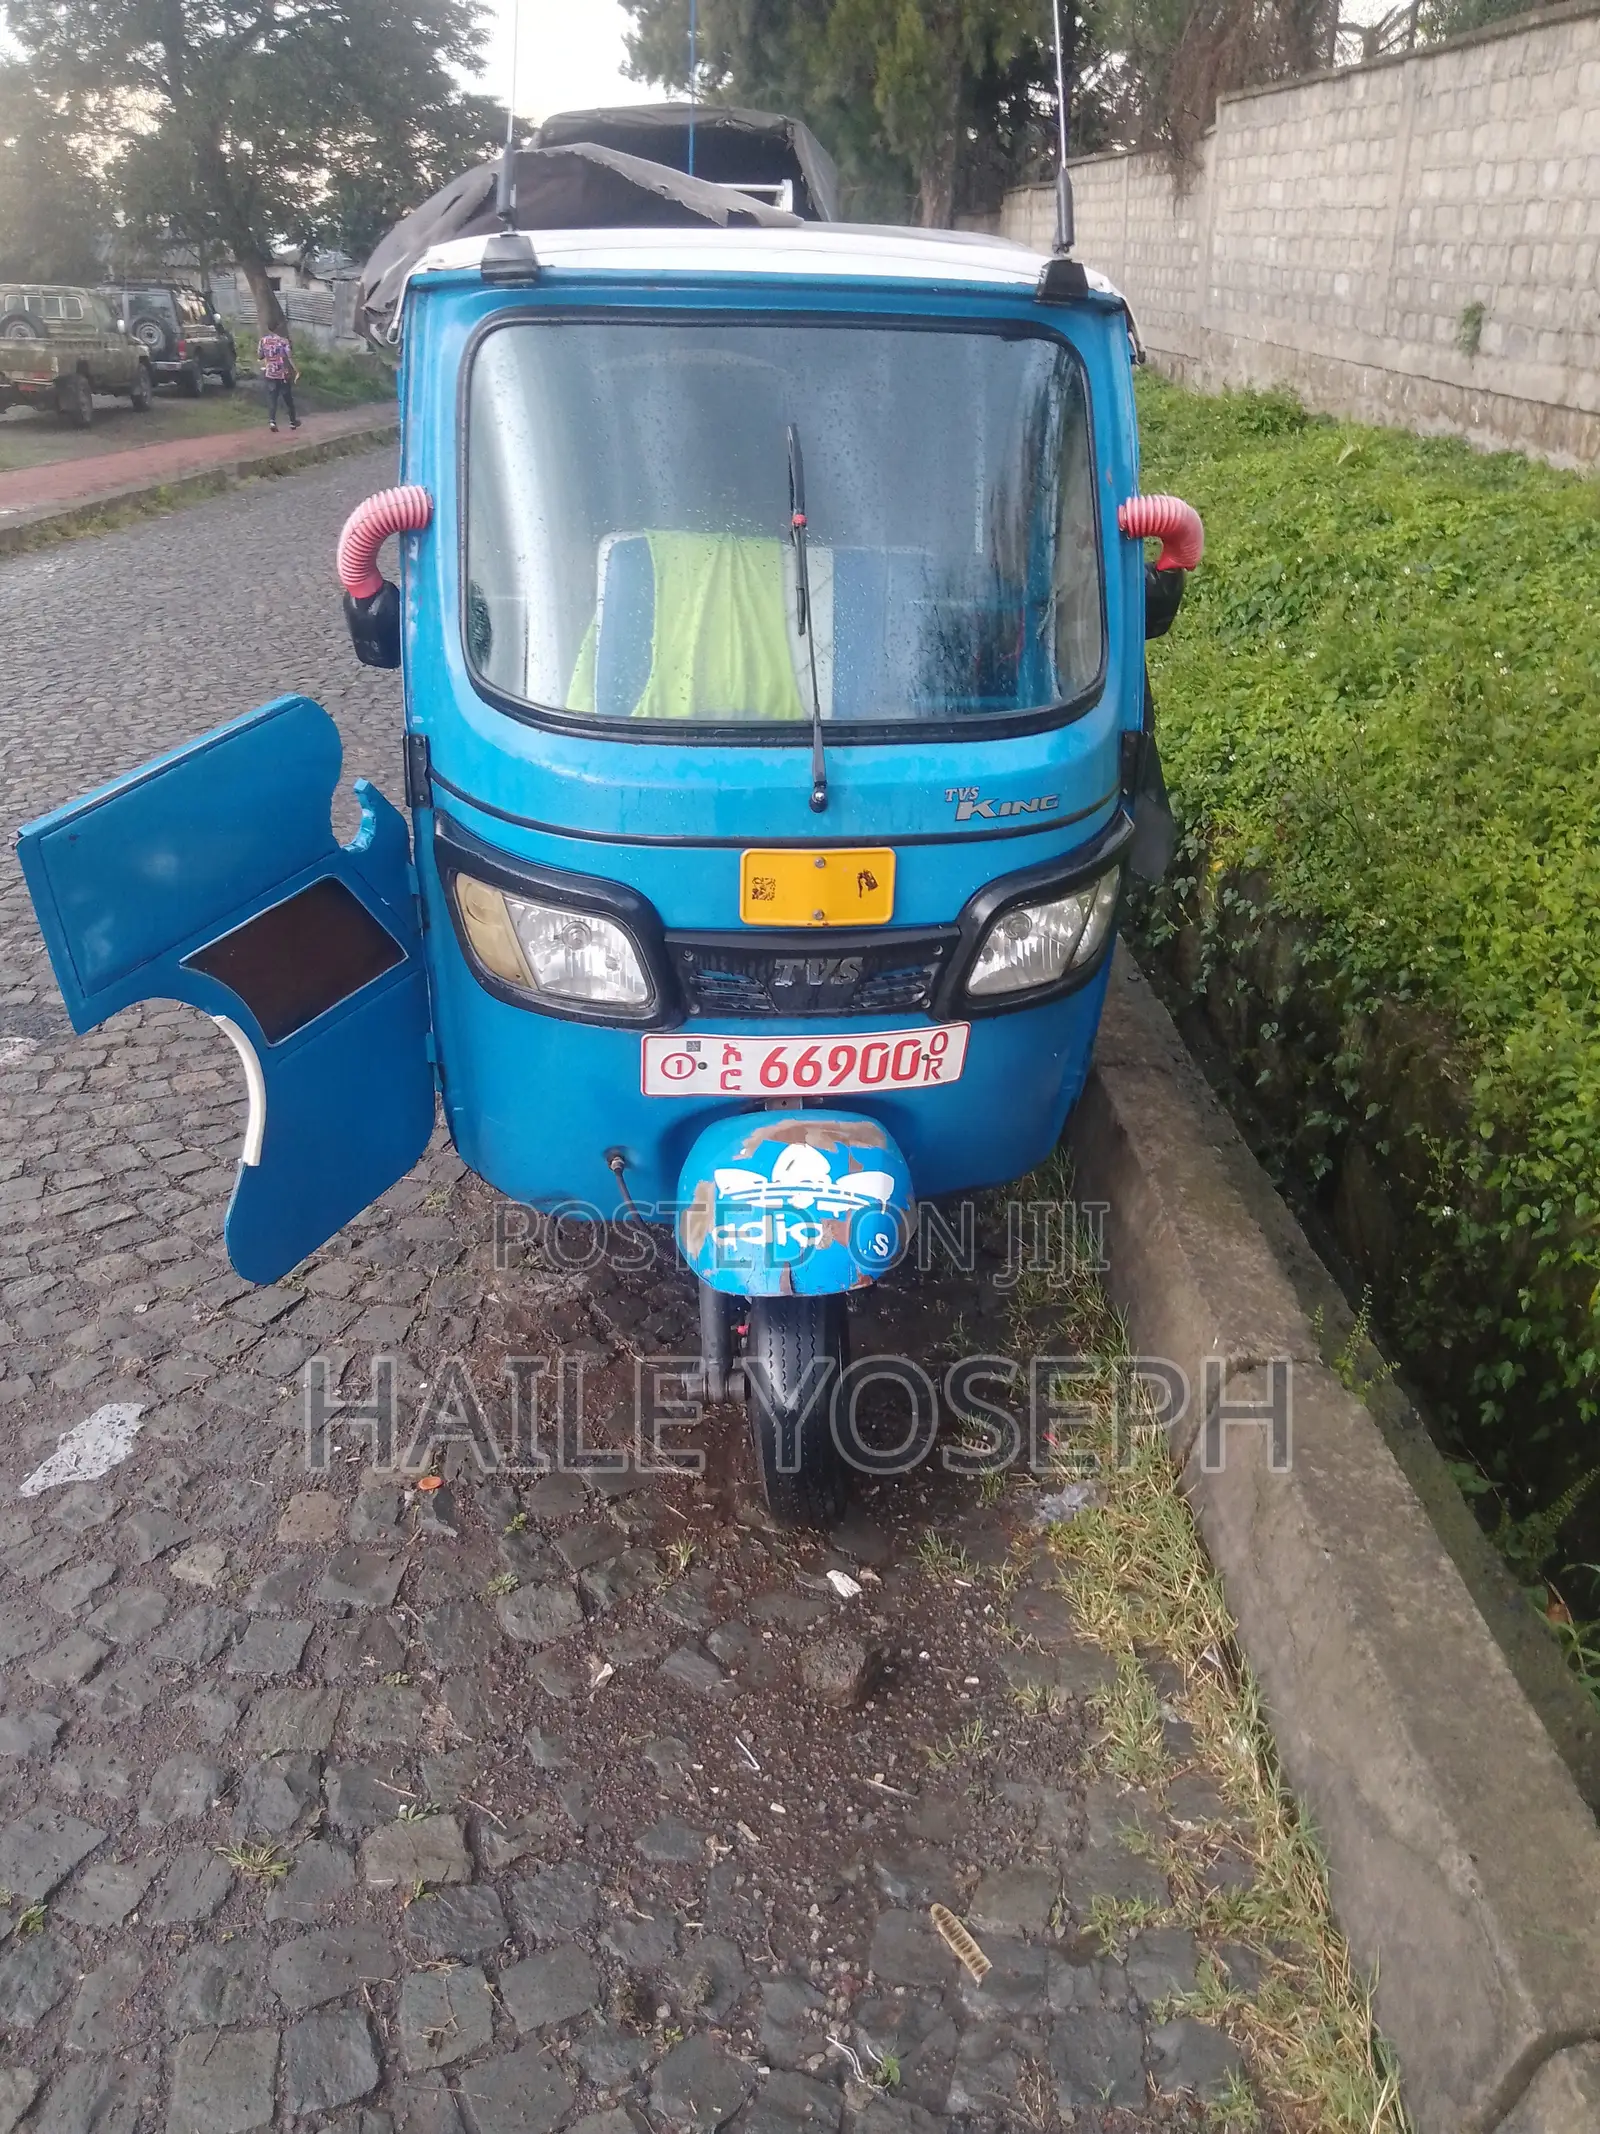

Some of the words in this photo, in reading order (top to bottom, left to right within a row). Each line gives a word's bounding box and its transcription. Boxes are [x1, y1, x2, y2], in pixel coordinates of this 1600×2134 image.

[945, 786, 979, 802] TVS
[955, 794, 1060, 821] KING
[774, 957, 863, 986] TVS
[759, 1038, 922, 1088] 66900
